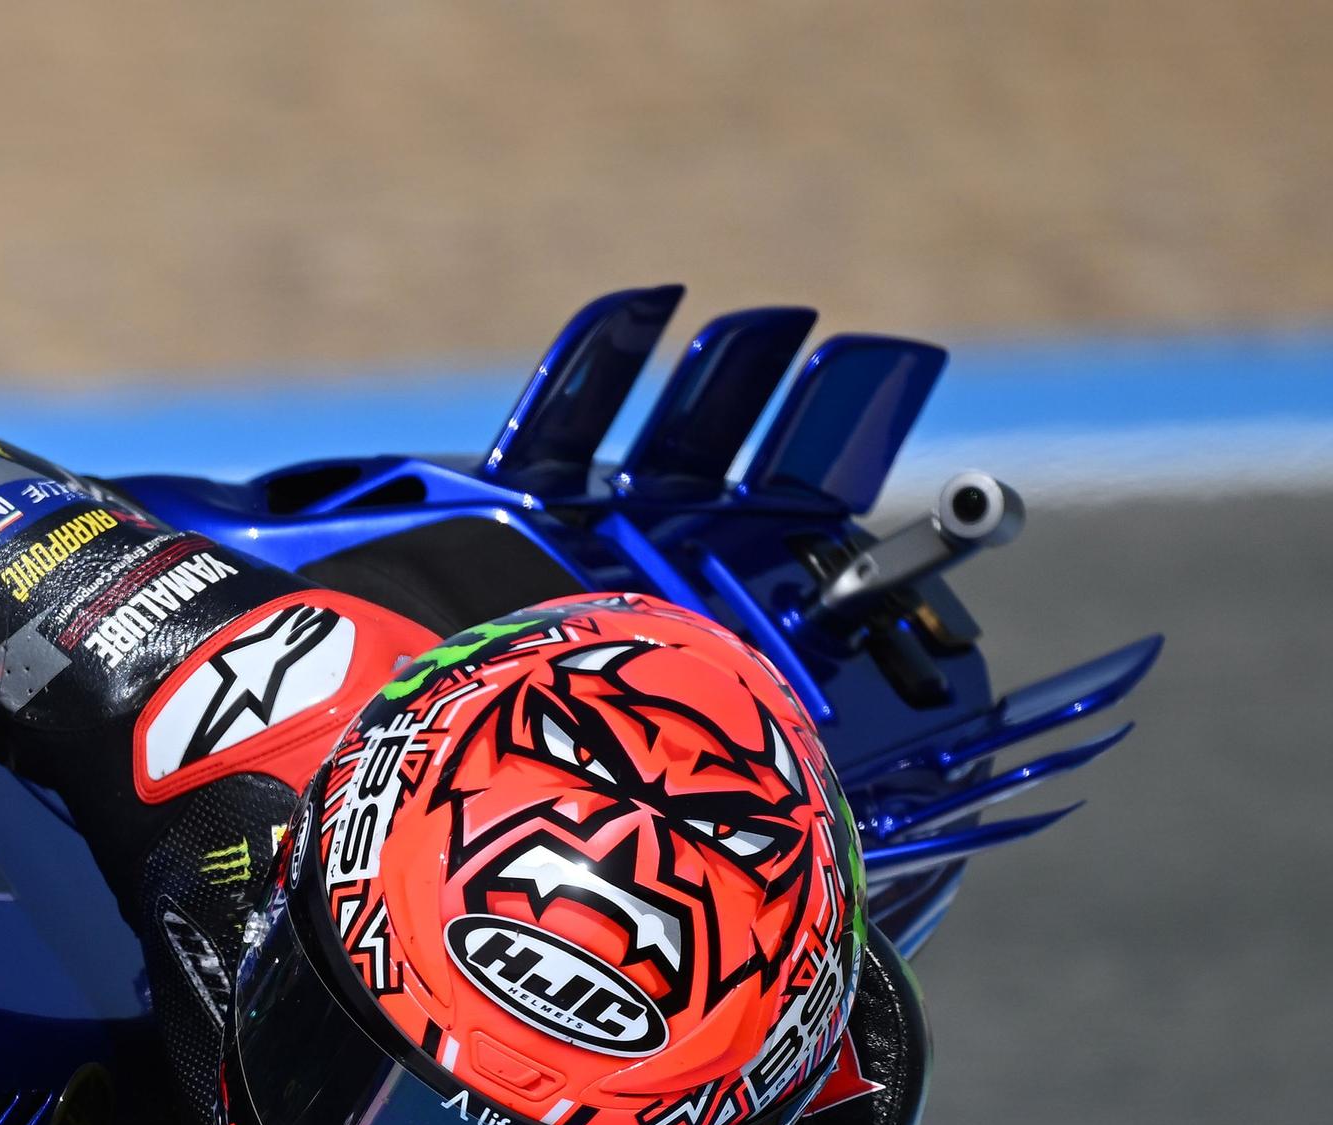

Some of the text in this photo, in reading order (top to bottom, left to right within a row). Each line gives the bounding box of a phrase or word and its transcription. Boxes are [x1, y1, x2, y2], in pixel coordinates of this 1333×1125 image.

[84, 552, 239, 669] YAMALUBE
[339, 735, 411, 876] BS
[469, 932, 647, 1038] HJC
[508, 987, 584, 1030] HELMETS
